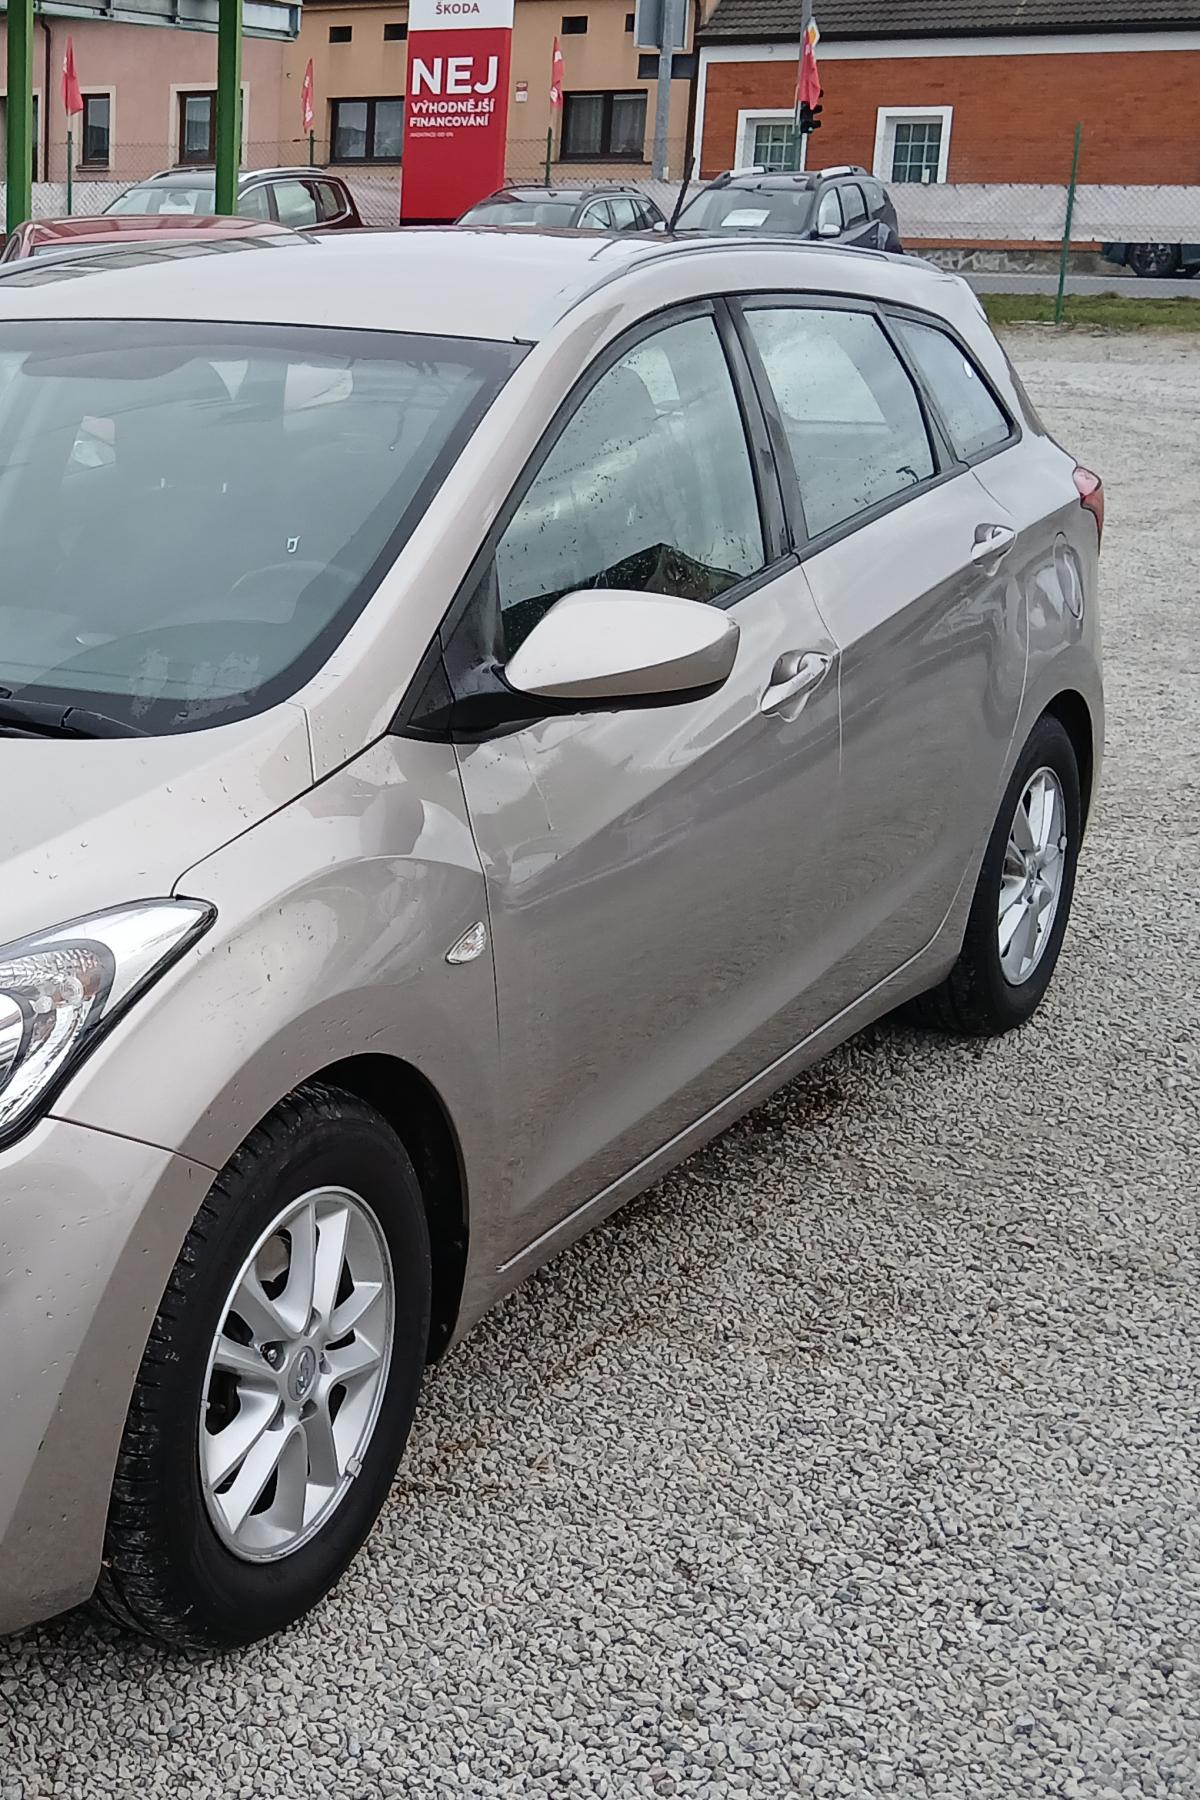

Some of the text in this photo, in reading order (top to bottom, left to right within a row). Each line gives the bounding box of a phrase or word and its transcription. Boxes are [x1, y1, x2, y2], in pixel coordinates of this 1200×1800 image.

[435, 1, 480, 15] ŠKODA
[411, 56, 499, 95] NEJ
[411, 98, 496, 114] VÝHODNĚJŠÍ
[409, 114, 489, 128] FINANCOVÁNÍ
